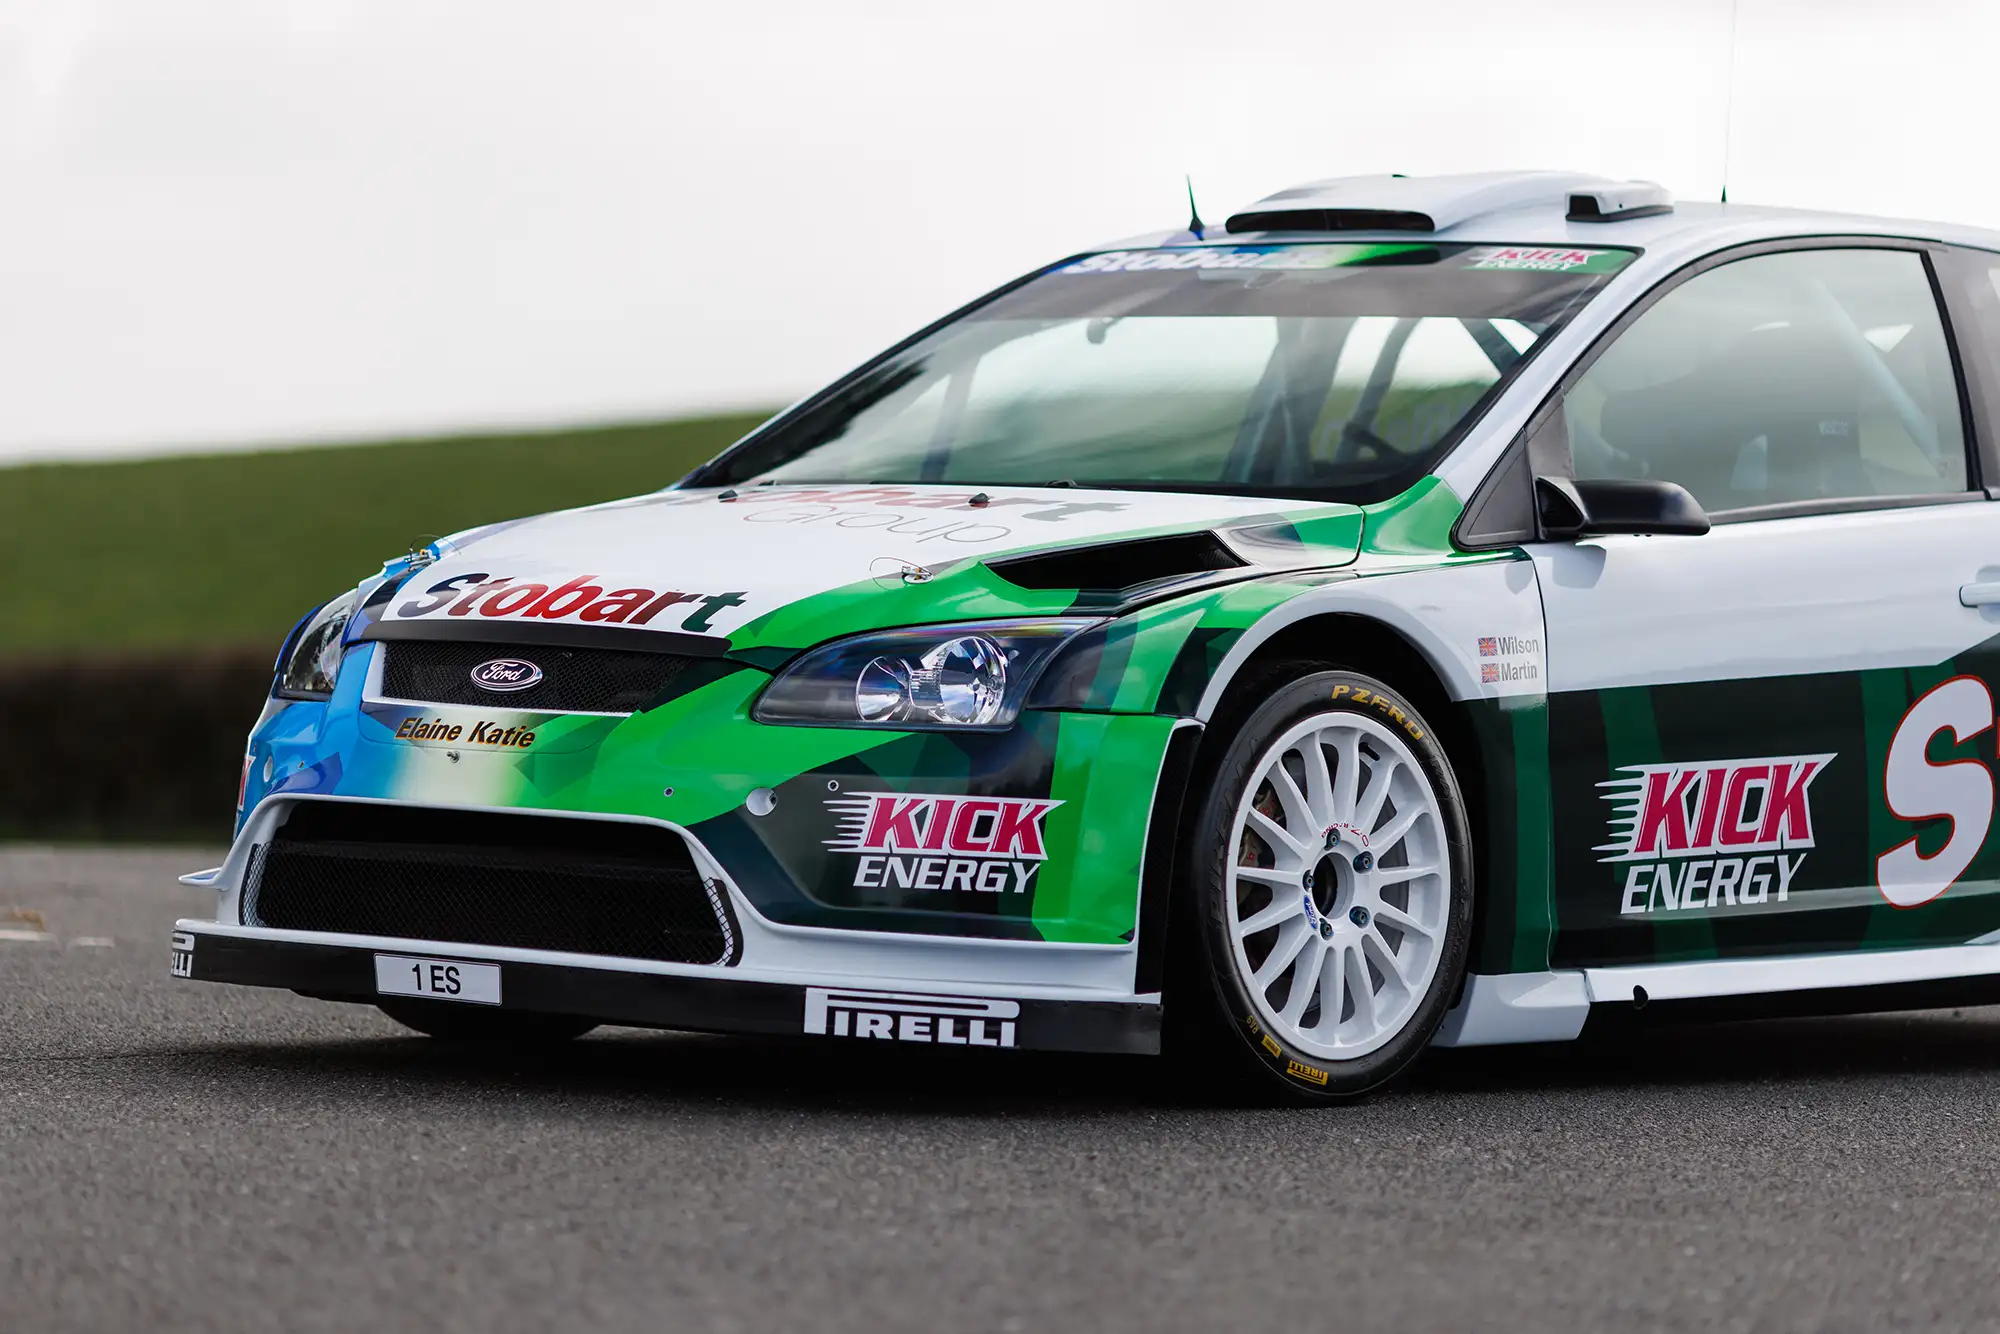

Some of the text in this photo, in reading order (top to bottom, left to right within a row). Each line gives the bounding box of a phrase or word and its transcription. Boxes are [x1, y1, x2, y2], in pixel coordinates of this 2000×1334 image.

[743, 504, 1011, 544] Group
[397, 572, 749, 633] Stobart
[1498, 636, 1539, 656] Wilson
[482, 662, 526, 681] Ford
[1500, 661, 1538, 681] Martin
[395, 717, 536, 748] Elaine Katie
[1628, 757, 1826, 858] KICK
[858, 794, 1056, 860] KICK
[853, 855, 1041, 893] ENERGY
[1620, 853, 1807, 914] ENERGY
[412, 964, 461, 995] 1 ES
[804, 987, 1020, 1047] PIRELLI
[1287, 1060, 1329, 1086] PIRELLI
